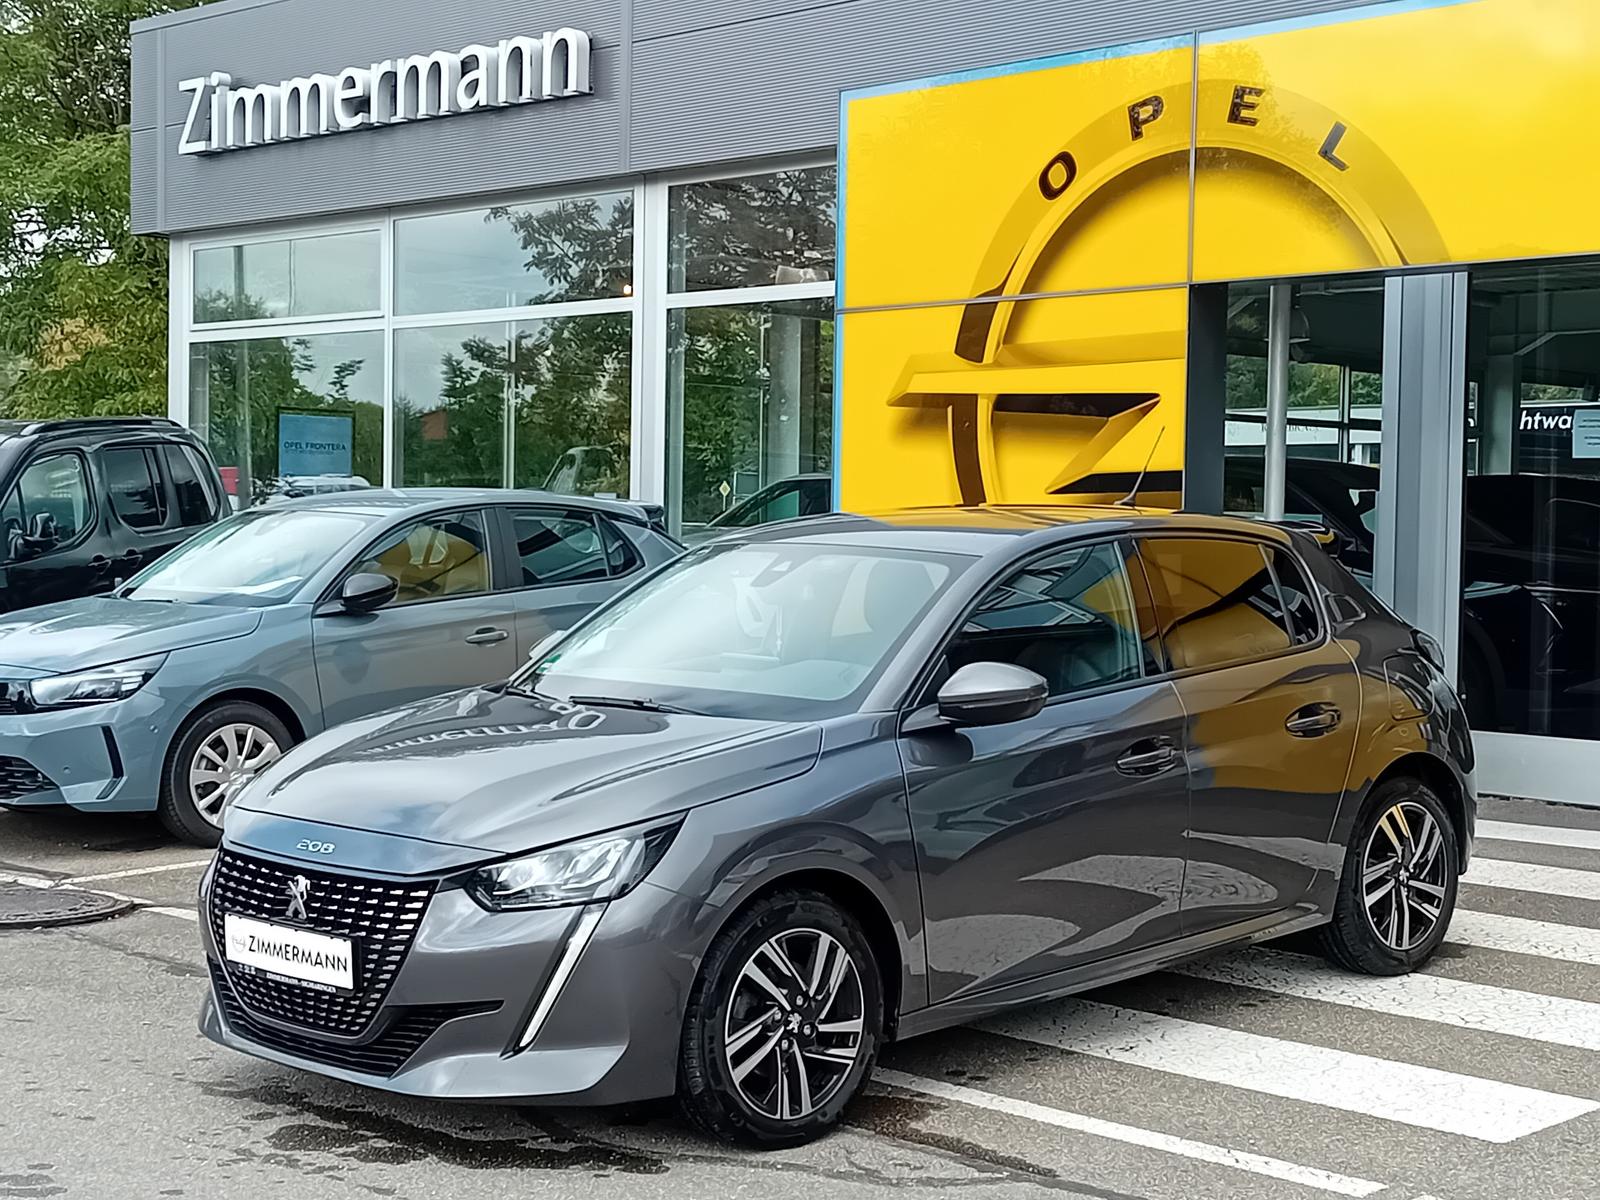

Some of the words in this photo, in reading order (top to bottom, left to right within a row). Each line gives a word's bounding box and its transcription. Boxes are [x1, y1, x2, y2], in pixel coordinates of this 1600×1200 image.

[178, 27, 592, 155] Zimmermann
[1038, 84, 1350, 201] OPEL
[283, 441, 302, 450] OPEL
[305, 442, 346, 451] FRONTERA
[296, 838, 336, 854] 208
[248, 935, 348, 973] ZIMMERMANN
